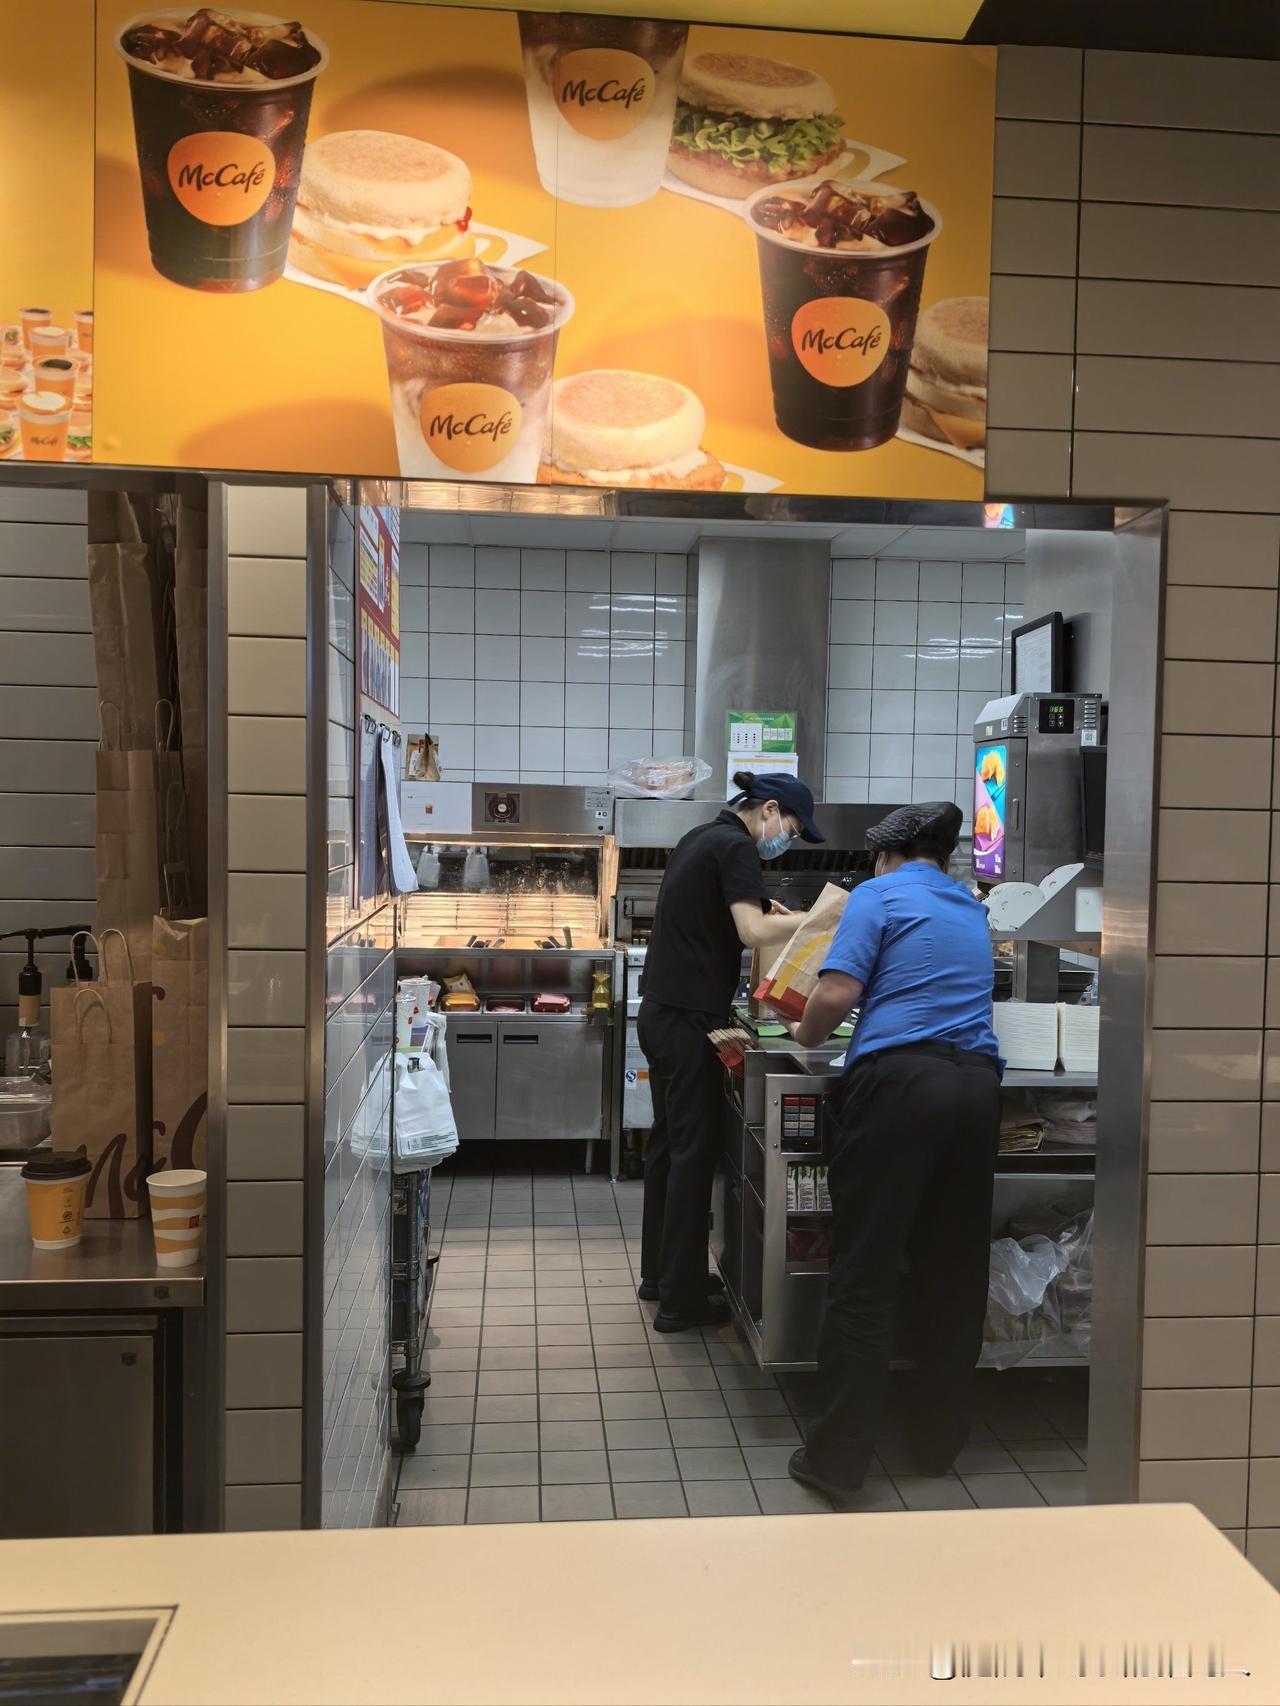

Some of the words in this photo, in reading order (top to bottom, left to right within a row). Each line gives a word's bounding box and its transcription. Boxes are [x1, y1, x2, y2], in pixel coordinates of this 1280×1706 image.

[562, 77, 646, 109] McCafé
[178, 161, 265, 193] McCafé
[801, 325, 882, 356] McCafé
[429, 411, 513, 442] McCafé
